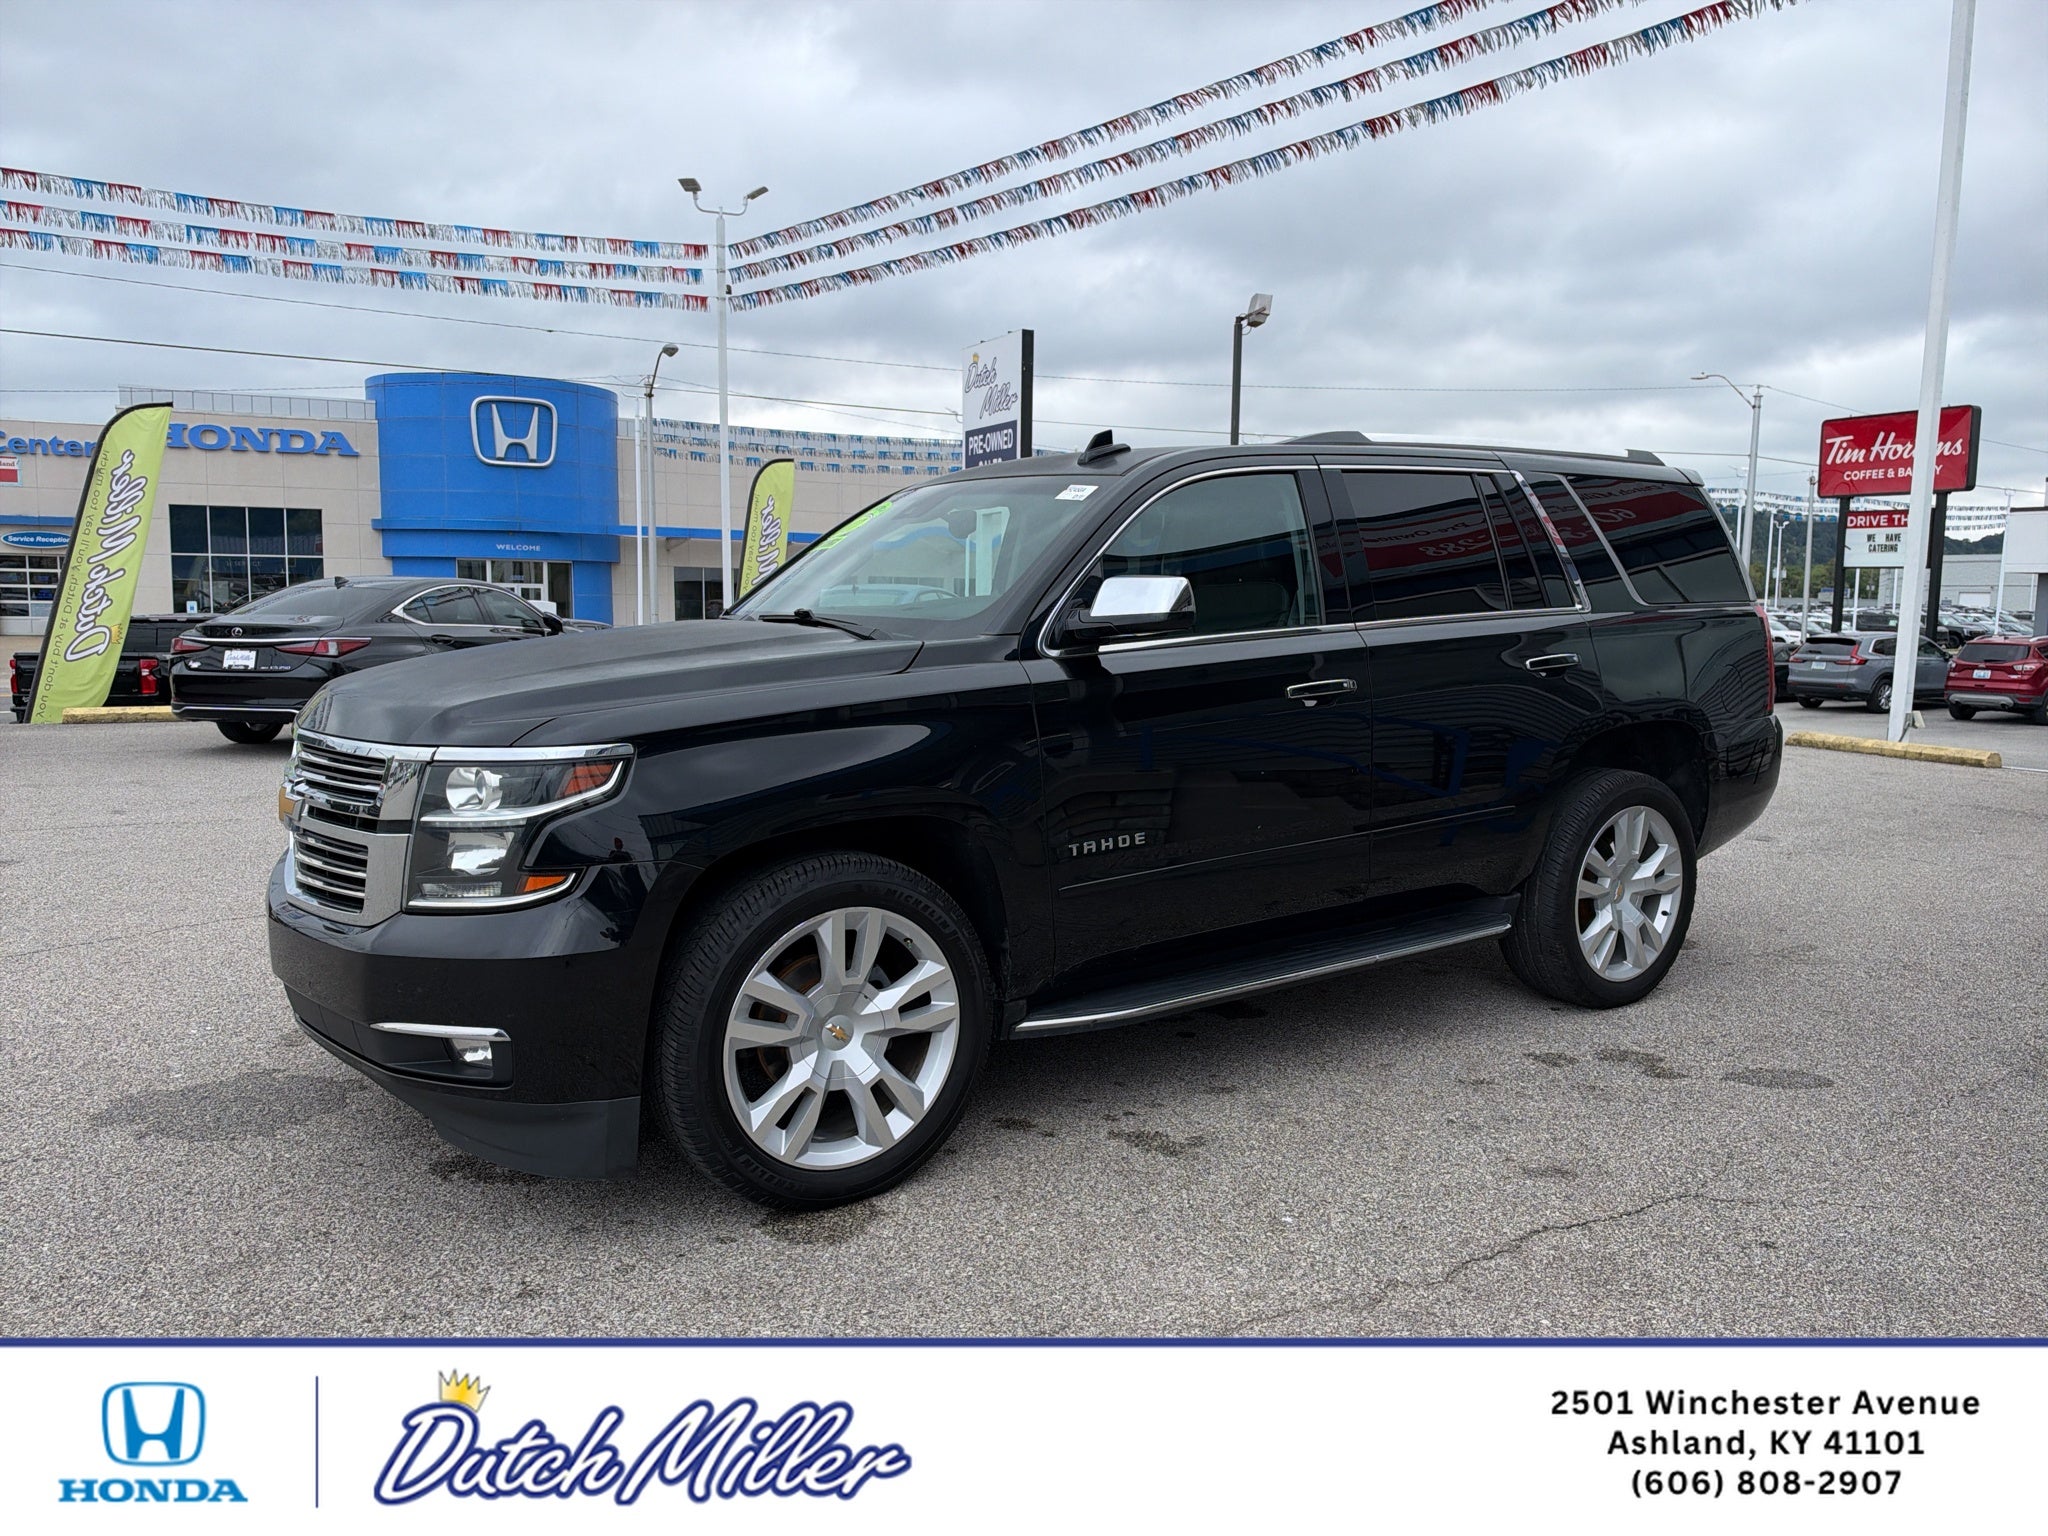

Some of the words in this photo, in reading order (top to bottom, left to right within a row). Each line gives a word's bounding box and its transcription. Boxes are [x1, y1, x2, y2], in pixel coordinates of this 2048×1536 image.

[965, 356, 997, 394] Dutch
[979, 381, 1019, 420] Miller
[968, 429, 1014, 456] PRE-OWNED
[1825, 435, 1866, 466] Tim
[1869, 431, 1964, 463] Horns
[1843, 468, 1885, 482] COFFEE
[1887, 467, 1896, 479] &
[1897, 464, 1944, 480] BAY
[1847, 515, 1889, 528] DRIVE
[1892, 514, 1909, 527] TH
[8, 535, 35, 543] Service
[1867, 533, 1876, 543] WE
[1885, 533, 1902, 543] HAVE
[496, 543, 542, 552] WELCOME
[1868, 543, 1899, 553] CATERING
[1068, 831, 1146, 857] TAHOE
